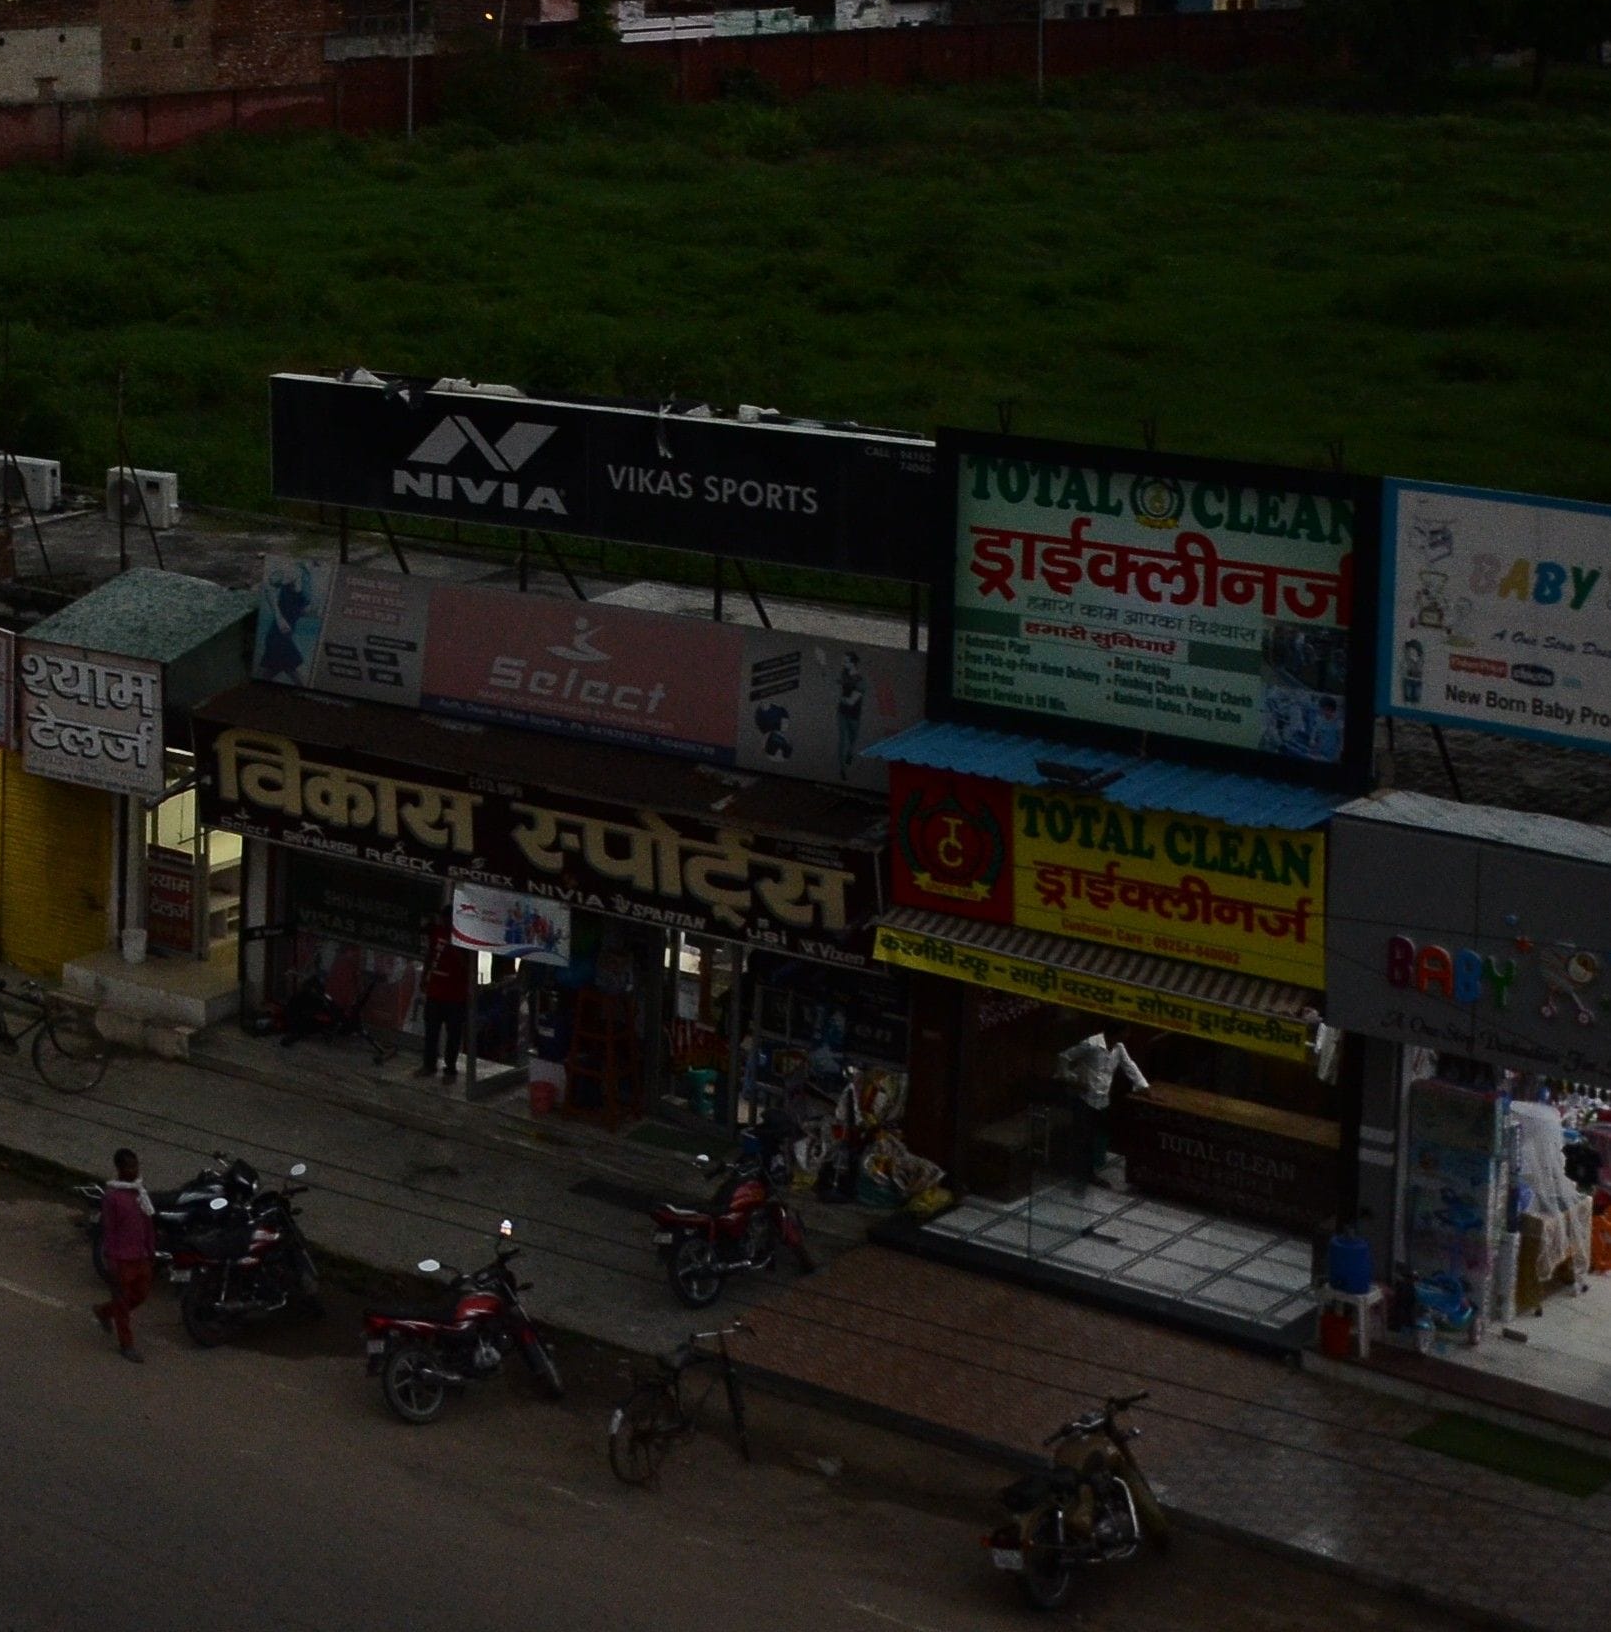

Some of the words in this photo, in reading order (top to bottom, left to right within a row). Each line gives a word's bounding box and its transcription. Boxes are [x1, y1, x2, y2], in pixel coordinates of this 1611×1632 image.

[392, 468, 564, 516] NIVIA
[606, 463, 694, 502] VIKAS
[703, 474, 820, 515] SPORTS
[965, 454, 1123, 517] TOTAL
[1469, 552, 1601, 611] BABY
[1026, 621, 1087, 641] हमारी
[1080, 603, 1119, 622] काम
[1125, 609, 1183, 631] आपका
[20, 653, 157, 718] श्याम
[488, 653, 668, 715] Select
[1445, 683, 1481, 705] New
[1485, 689, 1527, 714] Born
[1531, 697, 1575, 725] Baby
[27, 701, 155, 769] टेलर्ज
[215, 723, 484, 858] विकास
[508, 803, 857, 934] स्पोर्ट्स
[1018, 795, 1155, 860] TOTAL
[1165, 823, 1315, 887] CLEAN
[528, 880, 606, 910] NIVIA
[629, 902, 708, 930] SPARTAN
[1033, 859, 1313, 945] ड्राईक्लीनर्ज
[822, 945, 867, 967] Vixen
[1116, 928, 1144, 945] Care
[1386, 934, 1516, 1009] BABY
[1156, 1130, 1221, 1162] TOTAL
[1226, 1148, 1299, 1183] CLEAN
